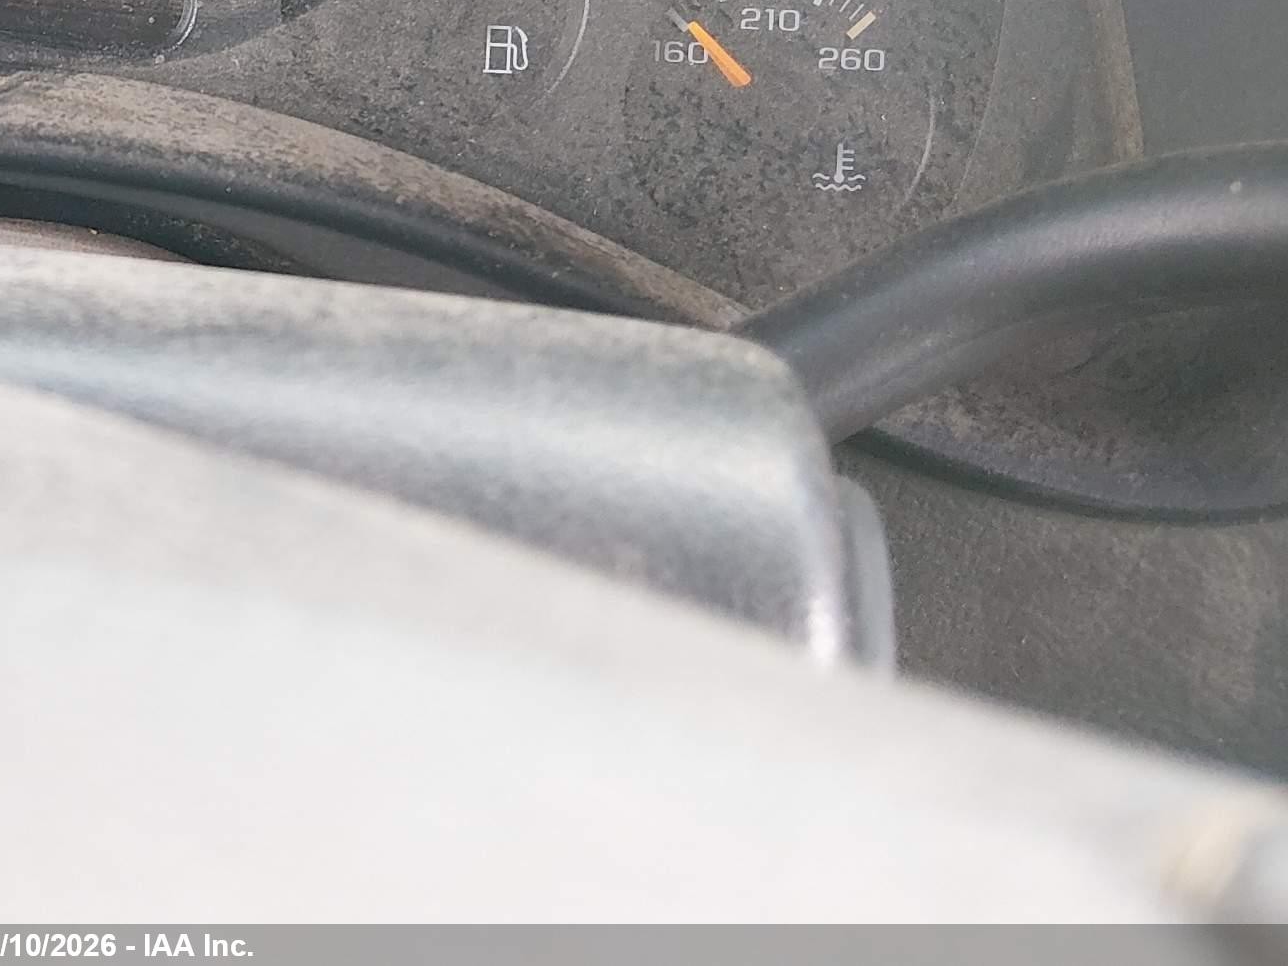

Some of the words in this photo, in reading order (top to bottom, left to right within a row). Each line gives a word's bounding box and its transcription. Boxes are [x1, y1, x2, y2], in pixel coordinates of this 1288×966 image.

[741, 8, 799, 31] 210
[652, 40, 709, 65] 160
[819, 48, 884, 70] 260
